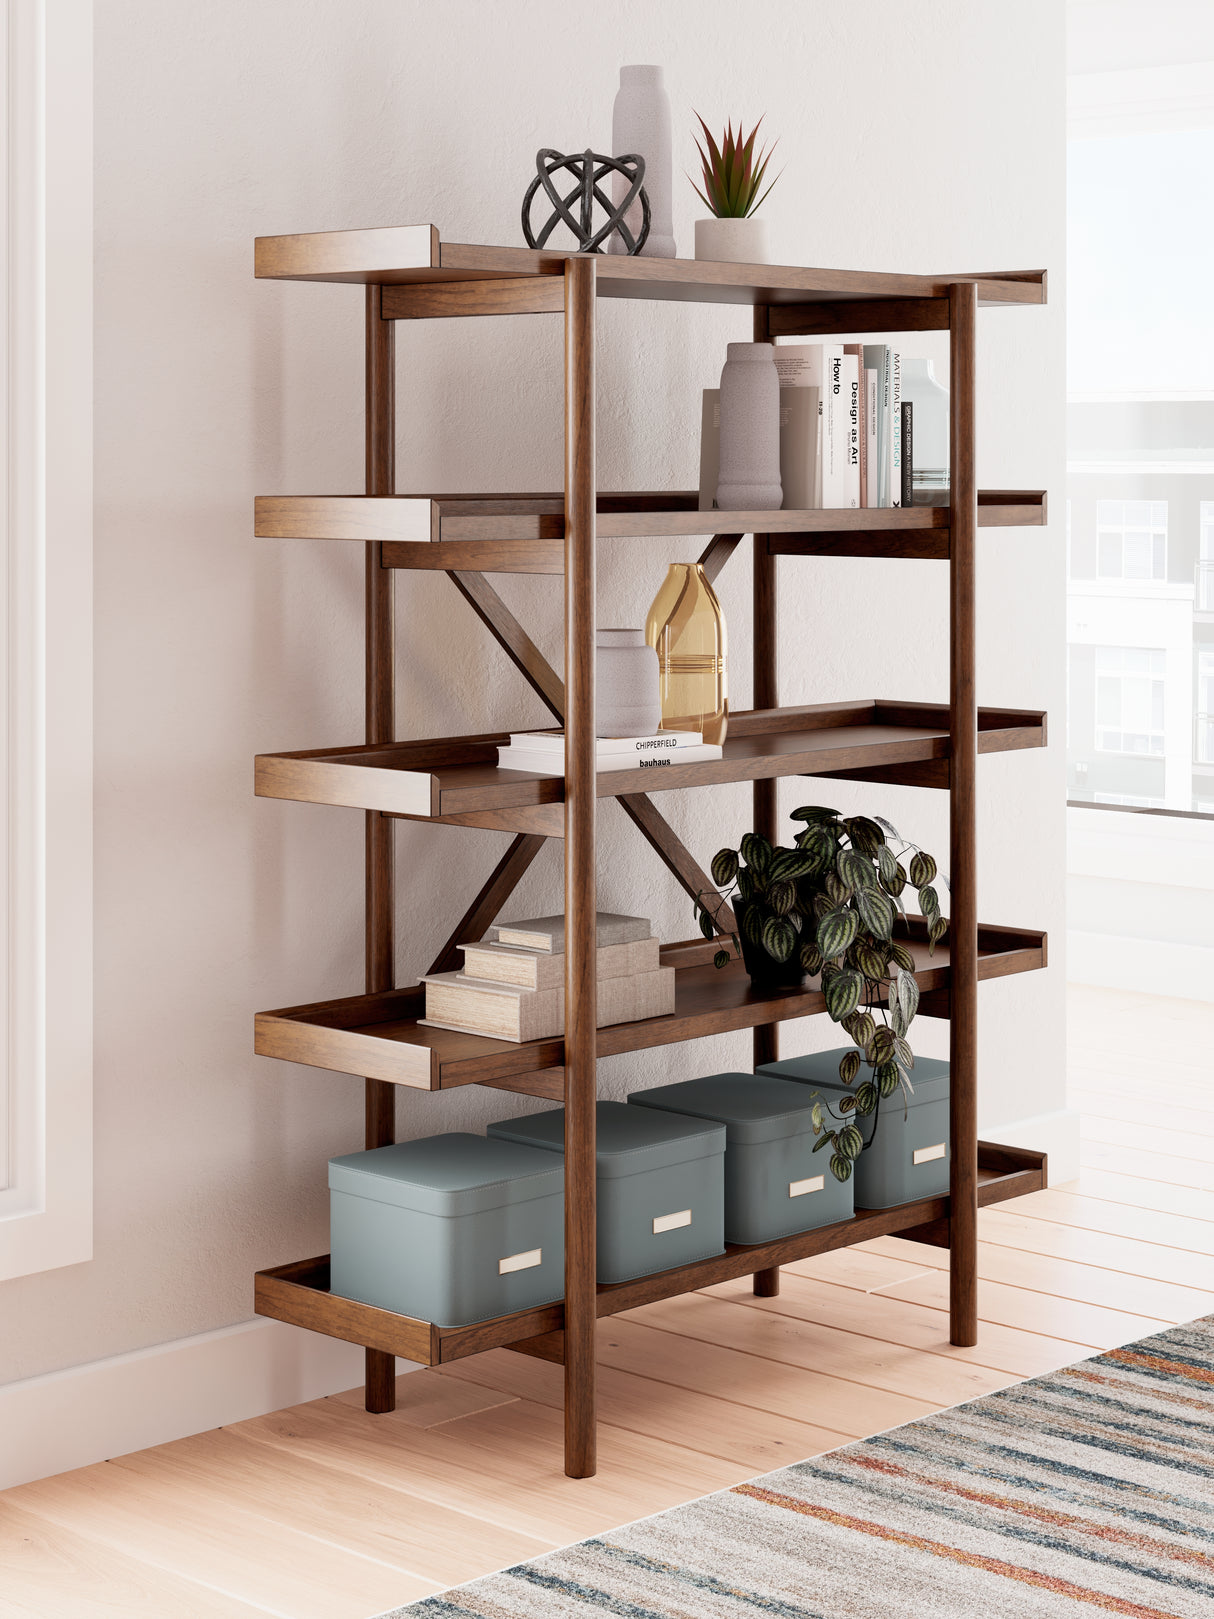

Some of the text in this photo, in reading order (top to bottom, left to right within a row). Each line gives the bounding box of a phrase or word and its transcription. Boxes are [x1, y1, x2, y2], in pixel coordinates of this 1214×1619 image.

[833, 358, 841, 395] How to
[850, 382, 859, 425] Design
[893, 415, 900, 424] &
[852, 428, 857, 443] as
[635, 738, 677, 750] CHIPPERFIELD
[639, 758, 671, 768] bauhaus
